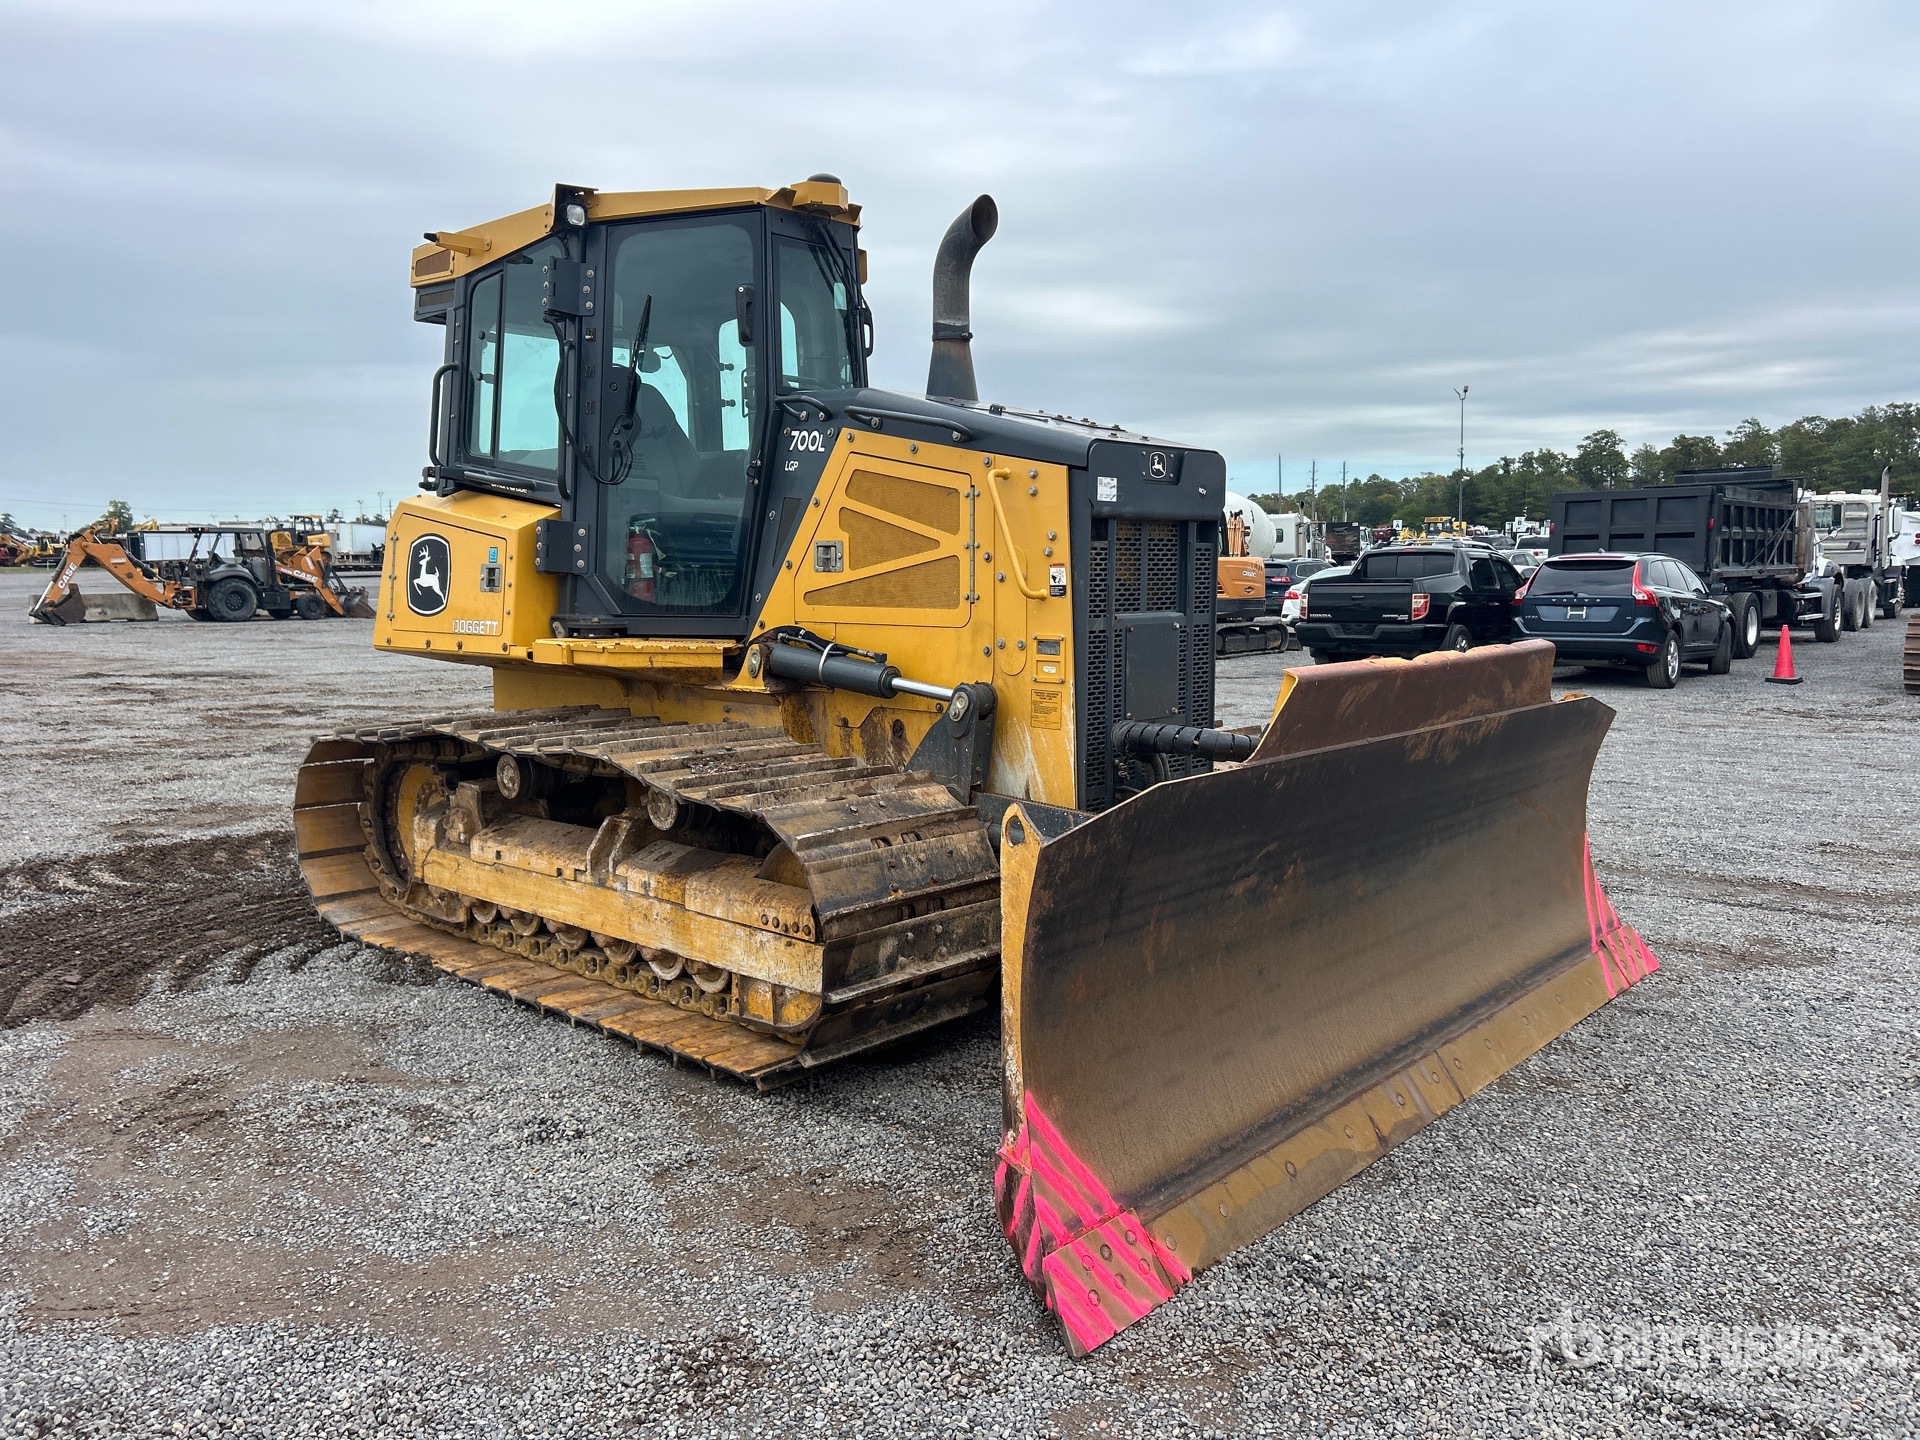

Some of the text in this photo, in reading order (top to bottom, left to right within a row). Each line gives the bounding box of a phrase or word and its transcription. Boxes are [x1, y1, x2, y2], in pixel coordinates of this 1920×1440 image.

[789, 430, 825, 452] 700L
[784, 460, 799, 471] LGP
[57, 562, 77, 589] CASE
[293, 569, 319, 584] CASE
[453, 619, 499, 636] DOGGETT
